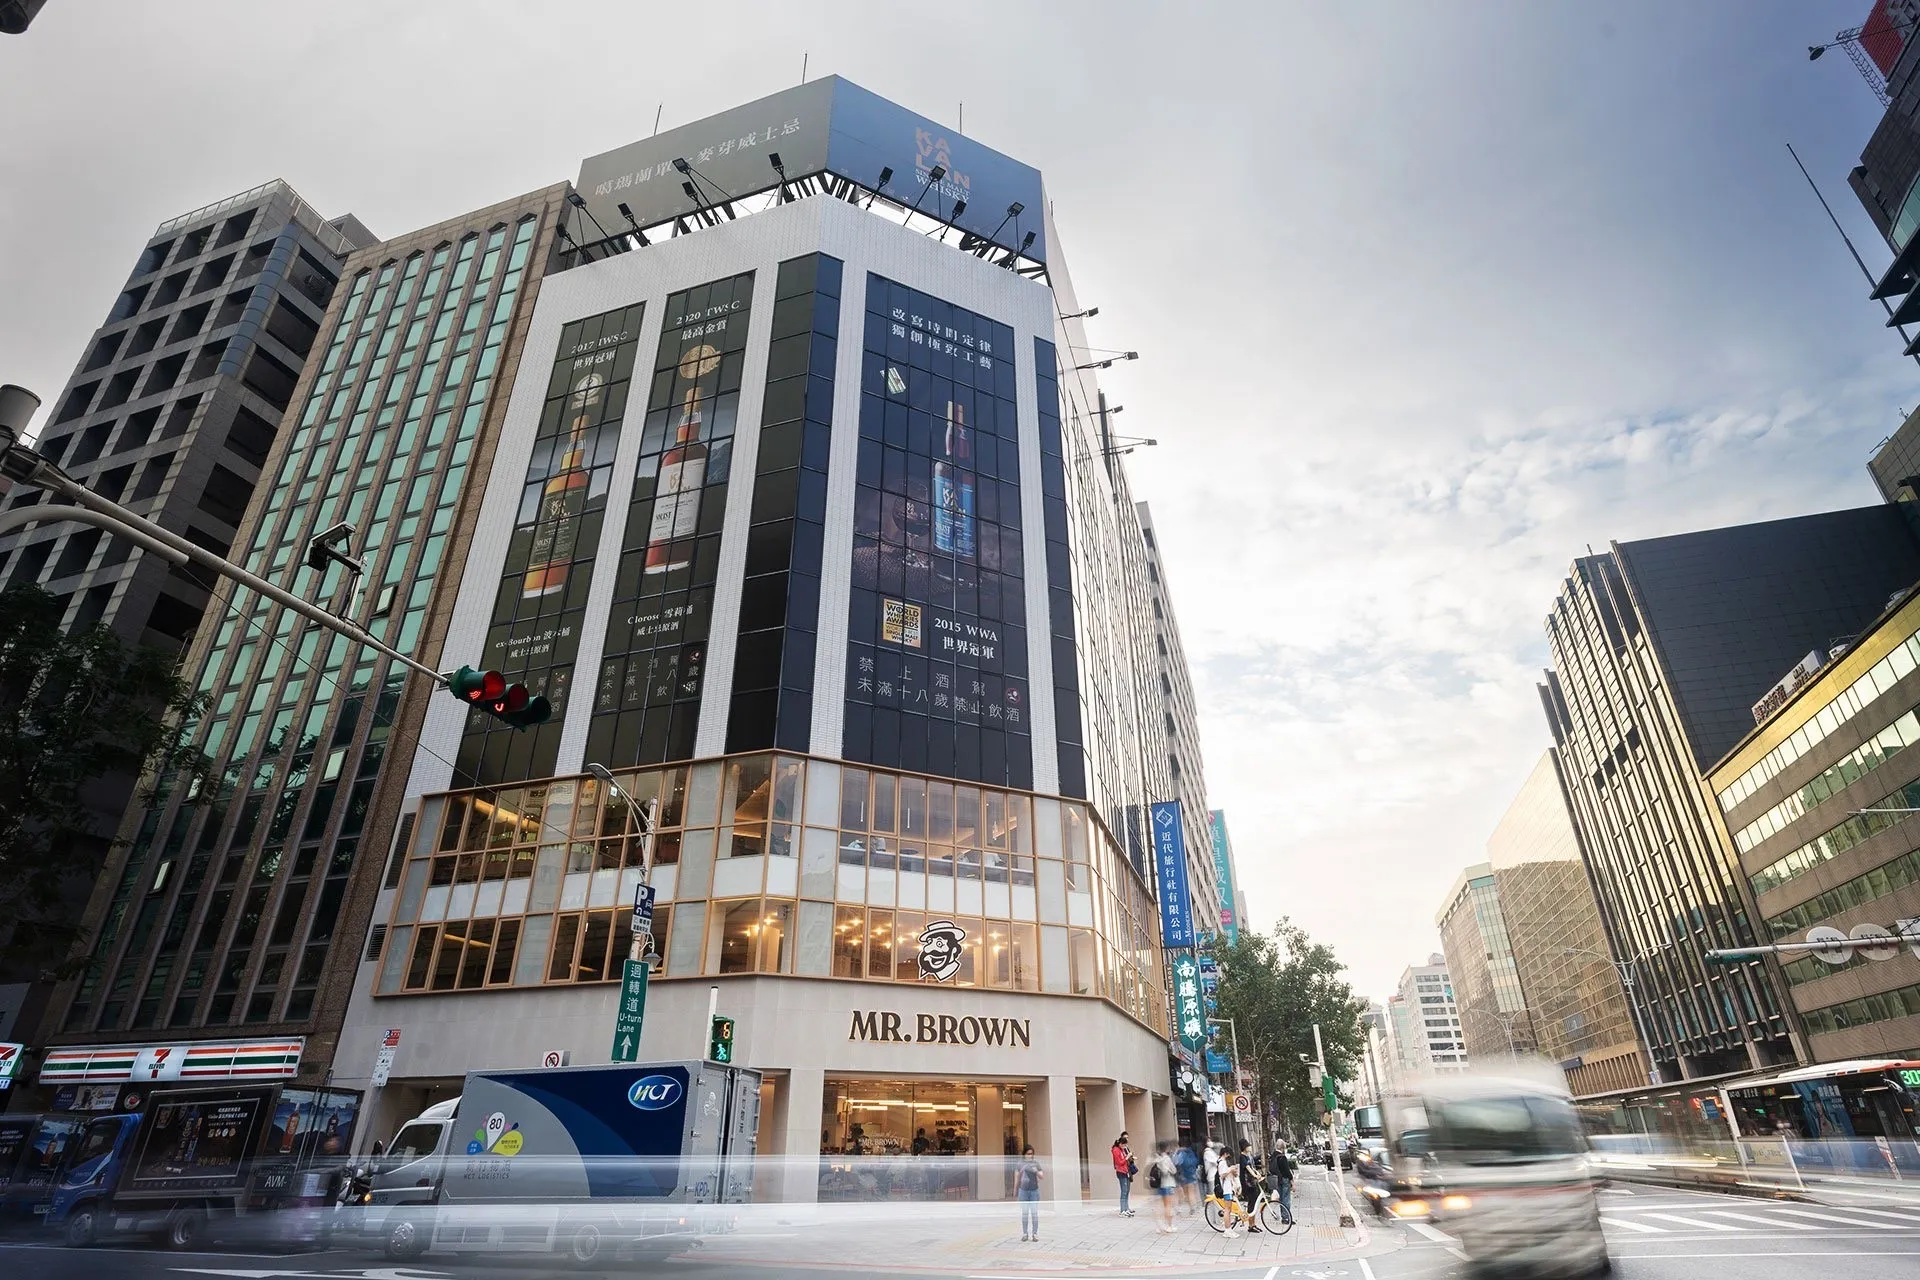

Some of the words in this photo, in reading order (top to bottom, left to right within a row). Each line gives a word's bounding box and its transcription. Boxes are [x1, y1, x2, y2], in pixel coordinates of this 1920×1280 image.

[892, 307, 992, 352] 改寫時間定律
[571, 341, 594, 353] 2017
[892, 323, 992, 370] 獨創極致工藝
[886, 604, 919, 617] WORLD
[886, 610, 919, 623] WHIKIES
[886, 616, 919, 629] AWARDS
[886, 629, 904, 637] SINGL
[934, 617, 962, 633] 2015
[965, 624, 998, 642] WWA
[891, 634, 913, 643] WHIKY
[942, 636, 995, 659] 世界冠軍
[858, 656, 986, 697] 禁止酒駕
[857, 677, 1020, 722] 未滿十八歲禁止飲酒
[636, 885, 648, 906] P
[1161, 831, 1182, 941] 近代旅行社有限公司
[626, 963, 642, 1013] 迴轉道
[617, 1022, 635, 1033] Lane
[619, 1012, 642, 1023] U-turn
[916, 1013, 1031, 1047] BROWN
[489, 1118, 503, 1130] 80
